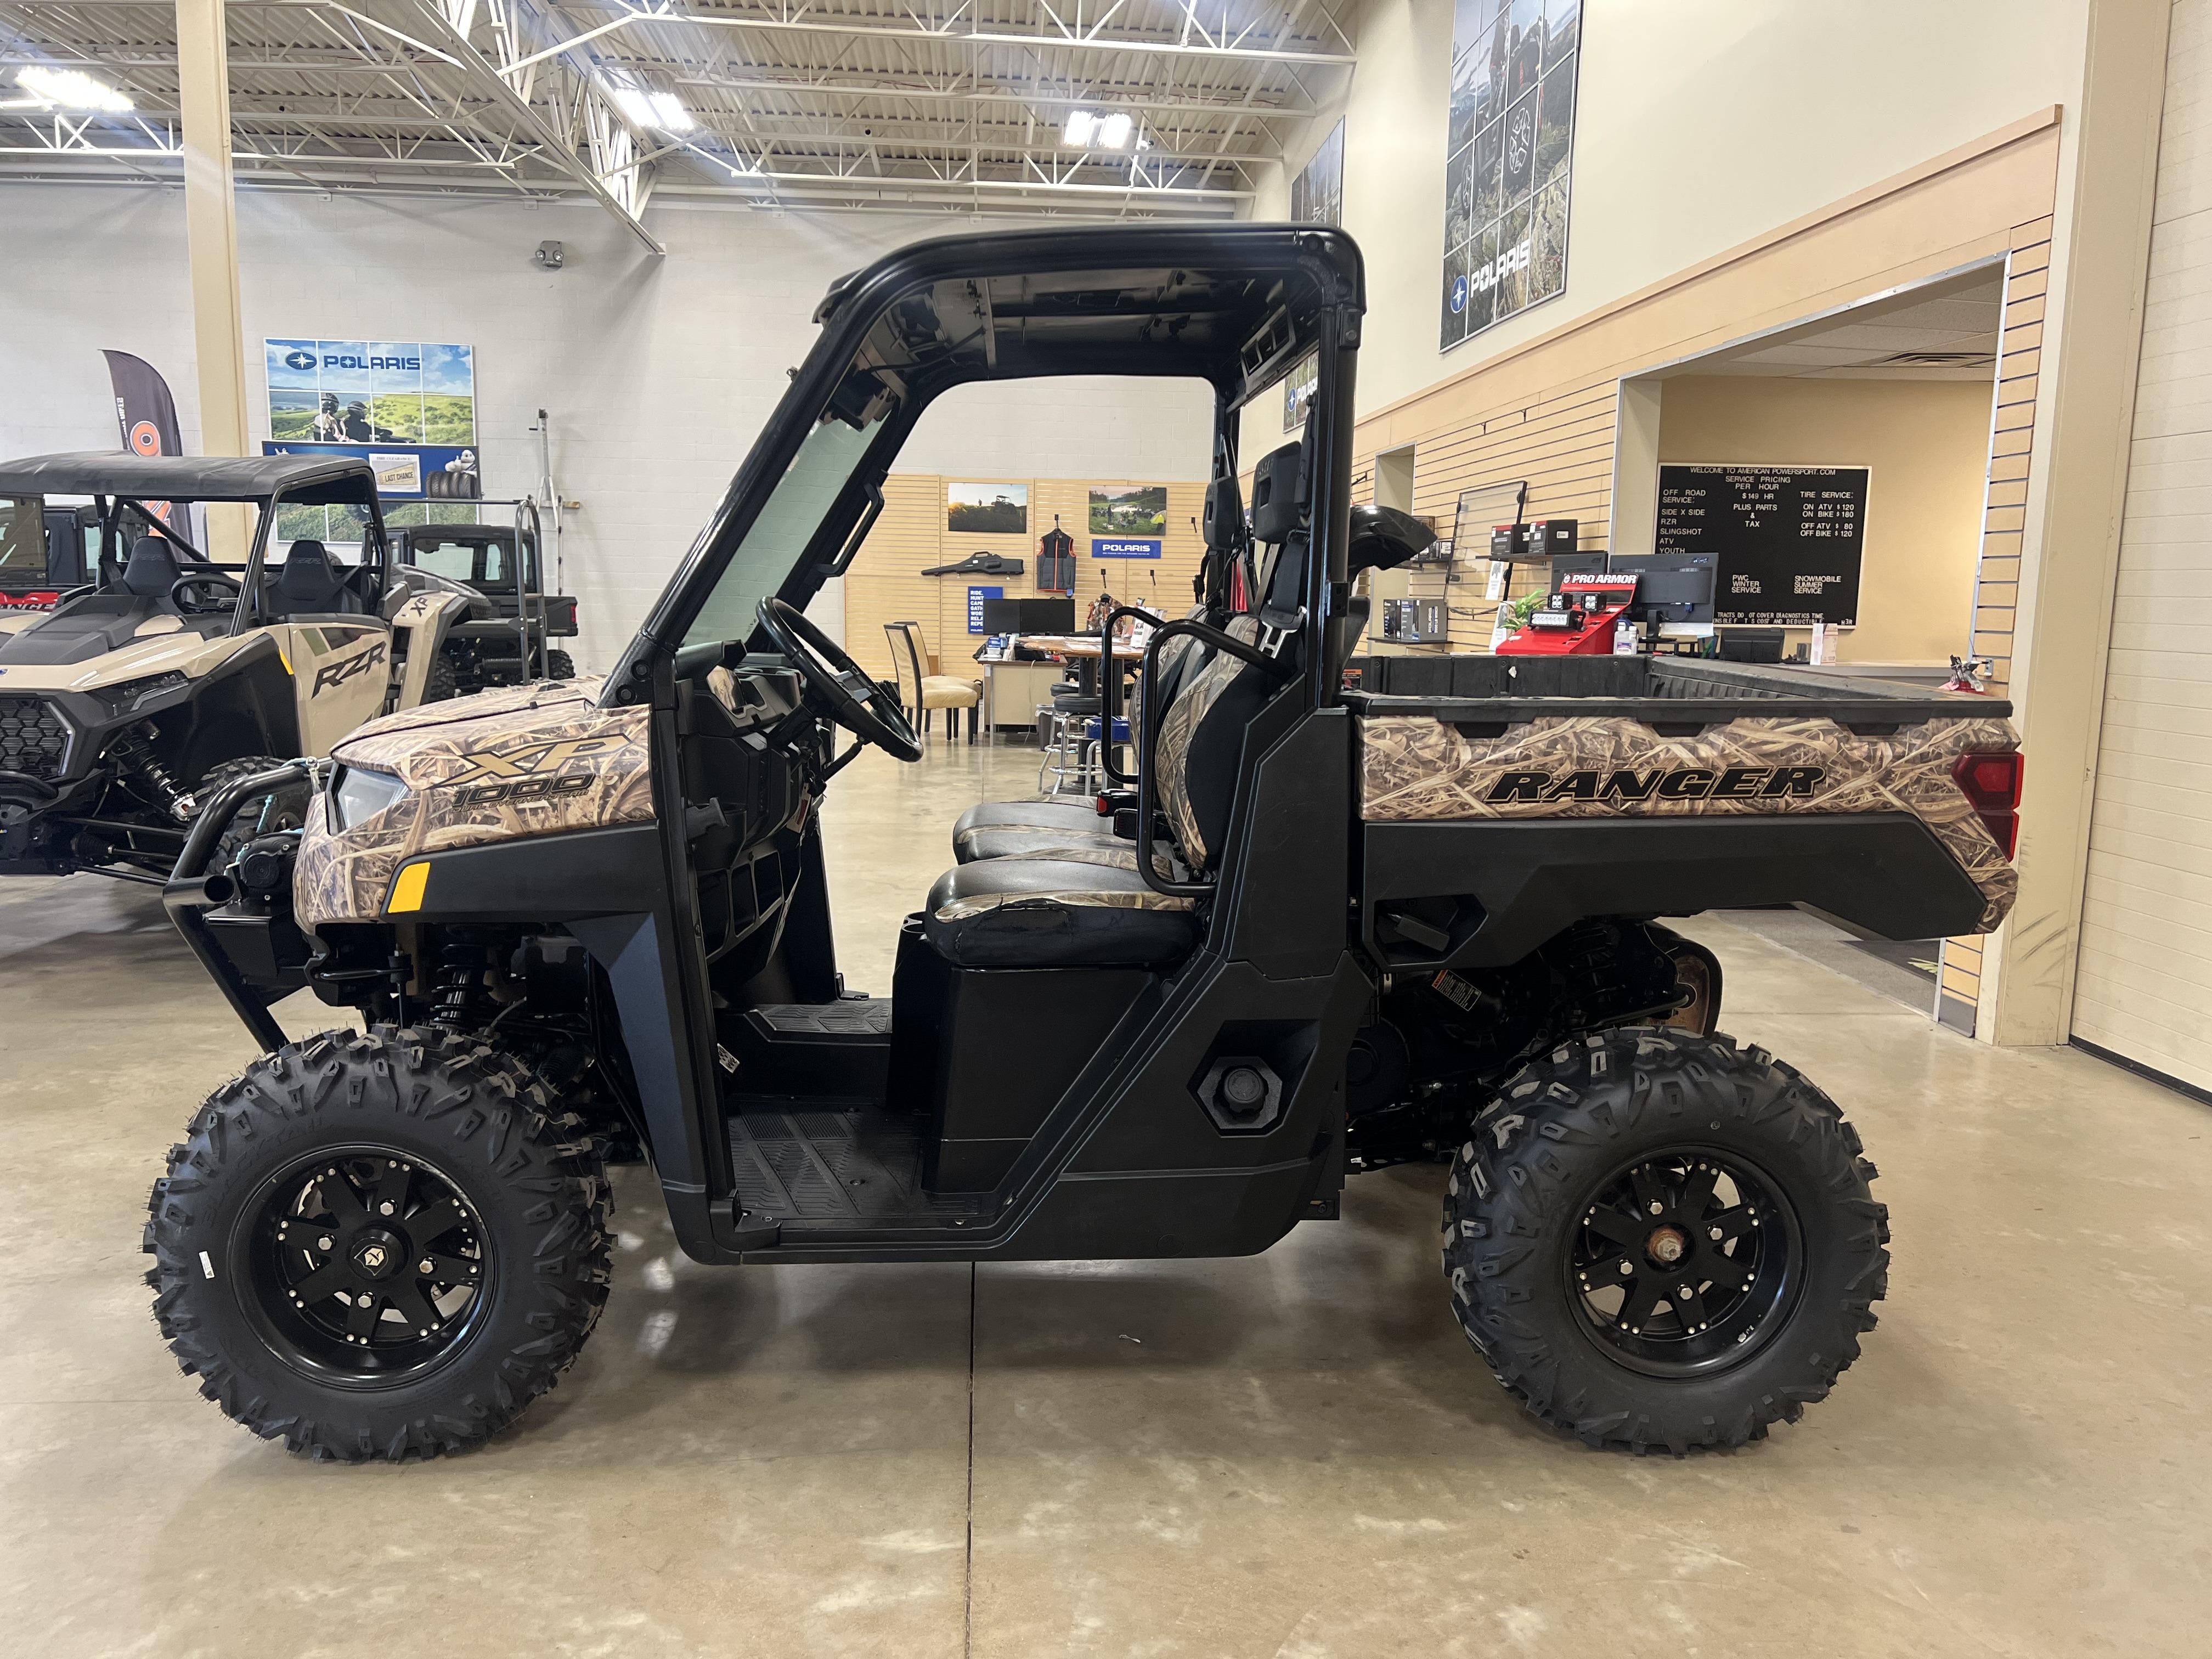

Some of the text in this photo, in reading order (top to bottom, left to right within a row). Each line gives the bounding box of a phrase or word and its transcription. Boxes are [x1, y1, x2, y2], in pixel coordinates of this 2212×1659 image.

[1470, 239, 1530, 298] POLARIS
[324, 356, 420, 370] POLARIS
[396, 472, 414, 480] CHANCE
[1571, 574, 1637, 584] PRO ARMOR
[410, 597, 428, 617] XP
[311, 641, 387, 700] RZR
[421, 732, 634, 791] XP
[452, 772, 596, 808] 1000
[1482, 765, 1826, 803] RANGER
[452, 789, 590, 813] DUAL OVERHEAD CAM
